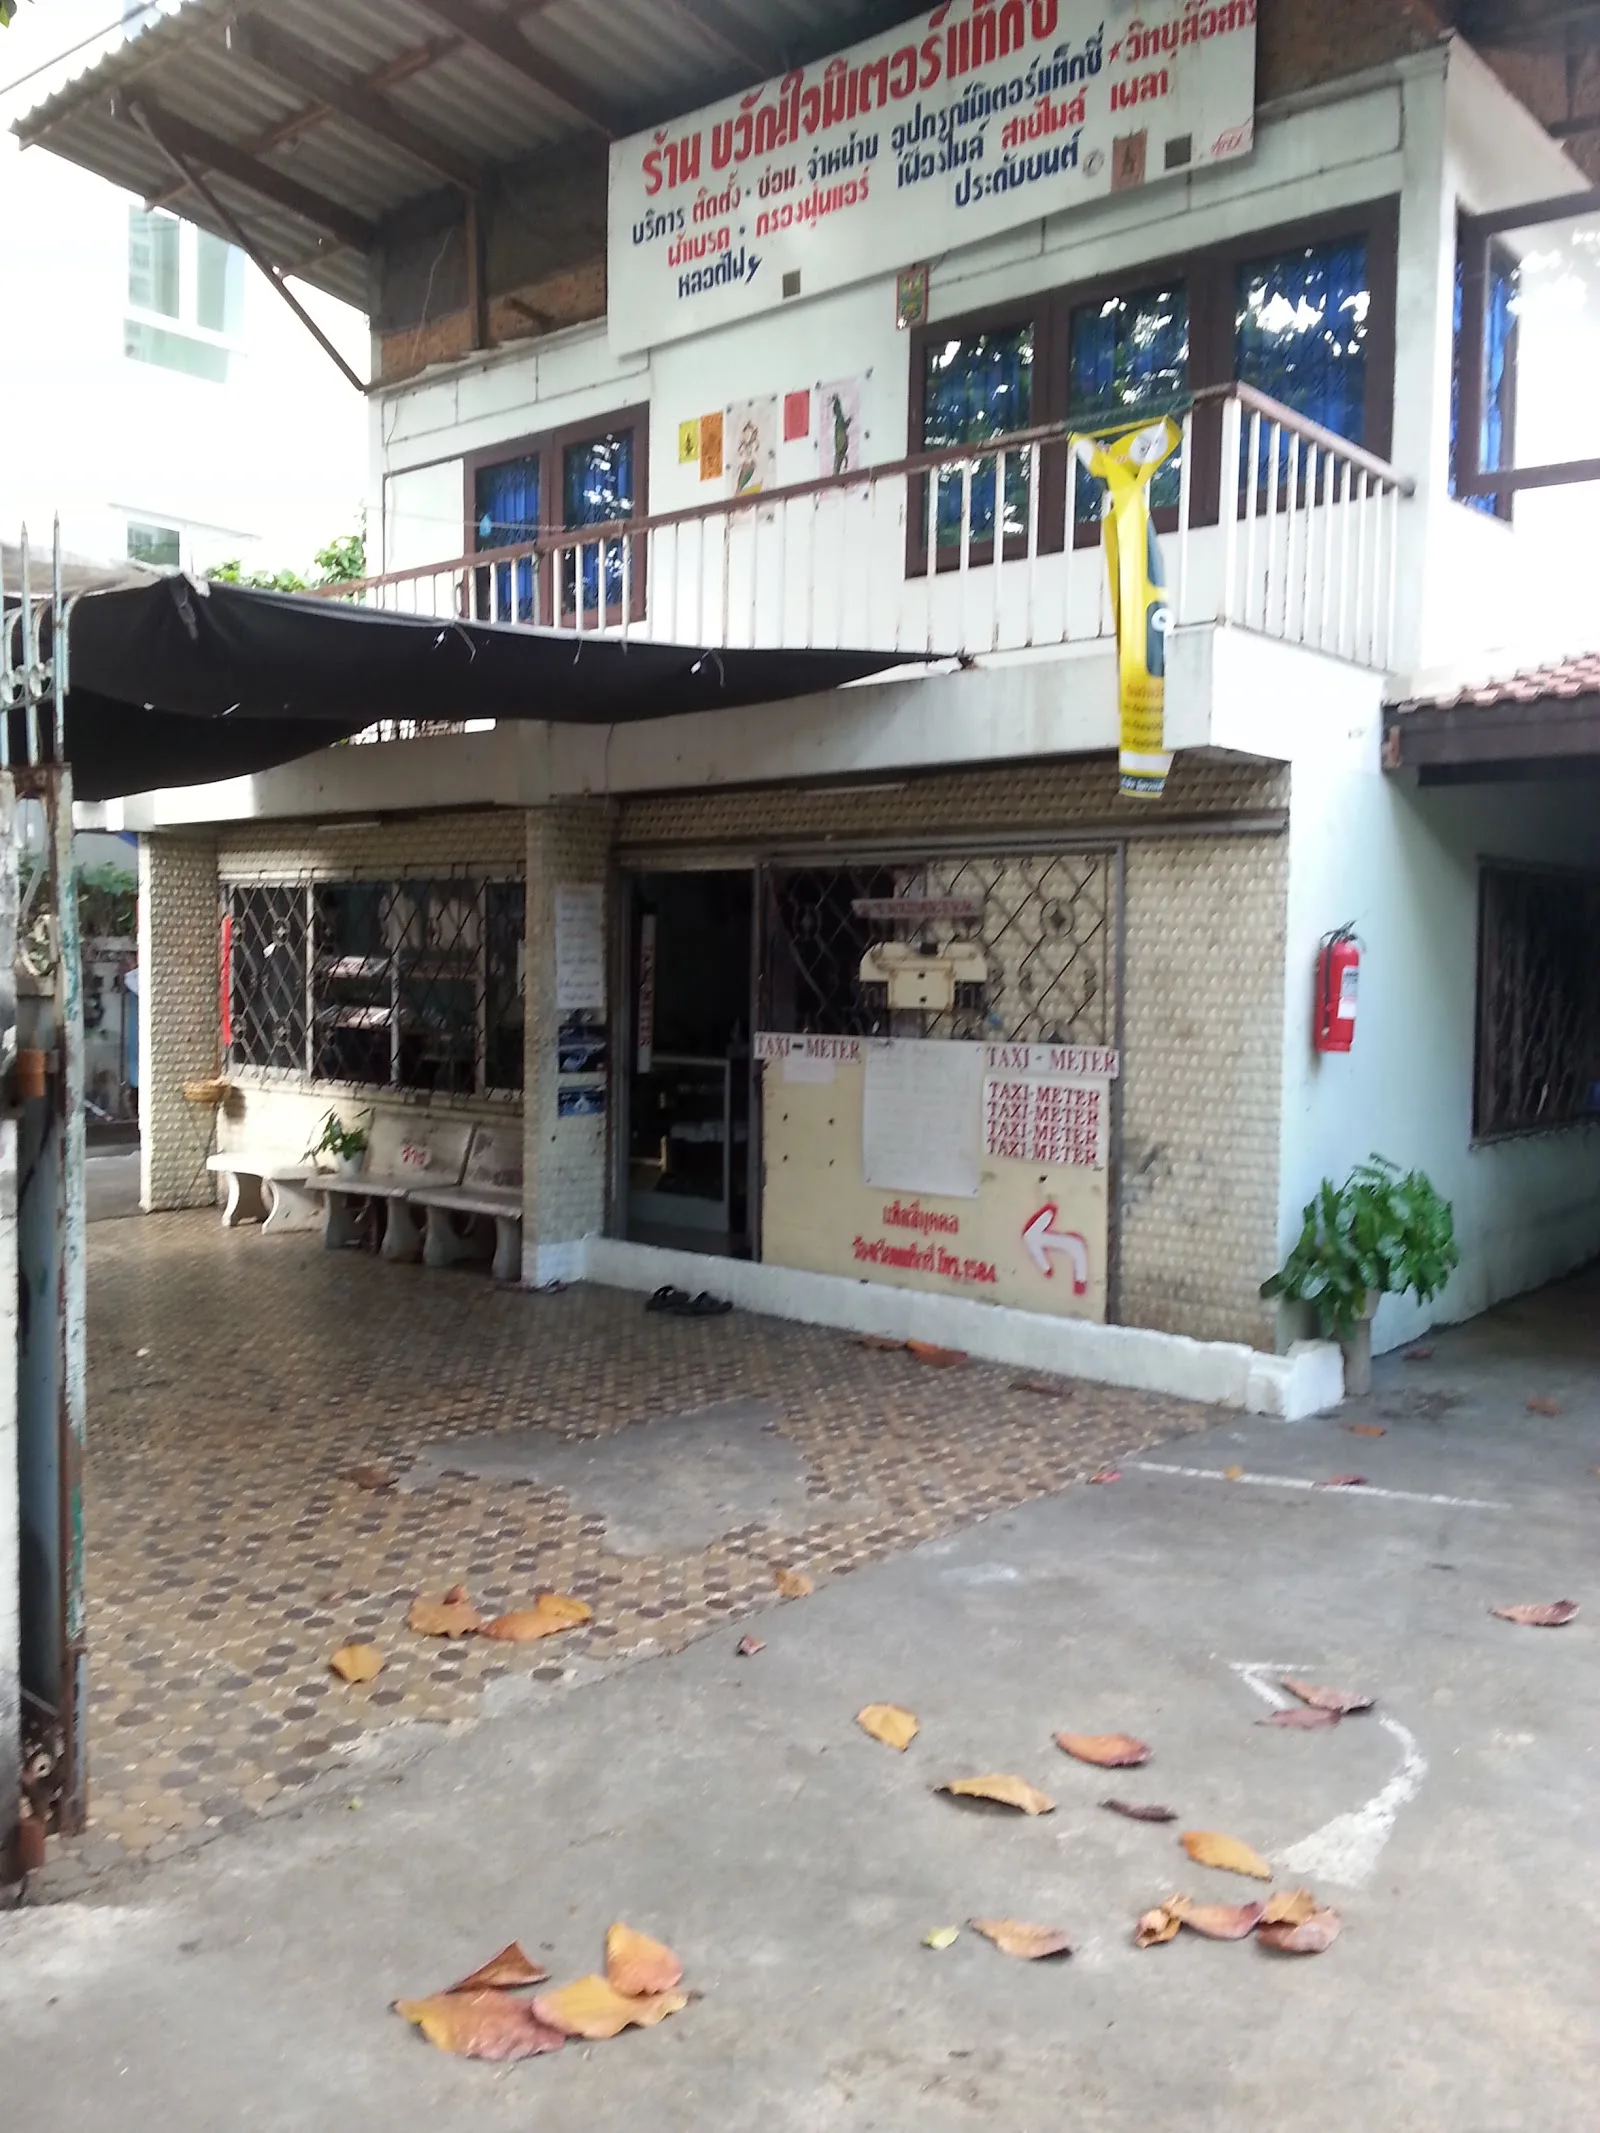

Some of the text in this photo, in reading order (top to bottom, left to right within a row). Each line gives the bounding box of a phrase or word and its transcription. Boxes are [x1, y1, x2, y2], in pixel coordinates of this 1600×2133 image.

[632, 206, 686, 246] บริการ
[692, 168, 741, 224] ติดตั้ง
[806, 129, 879, 181] จำหน่าย
[641, 128, 702, 196] ร้าน
[954, 126, 1085, 208] ประดับยนต์
